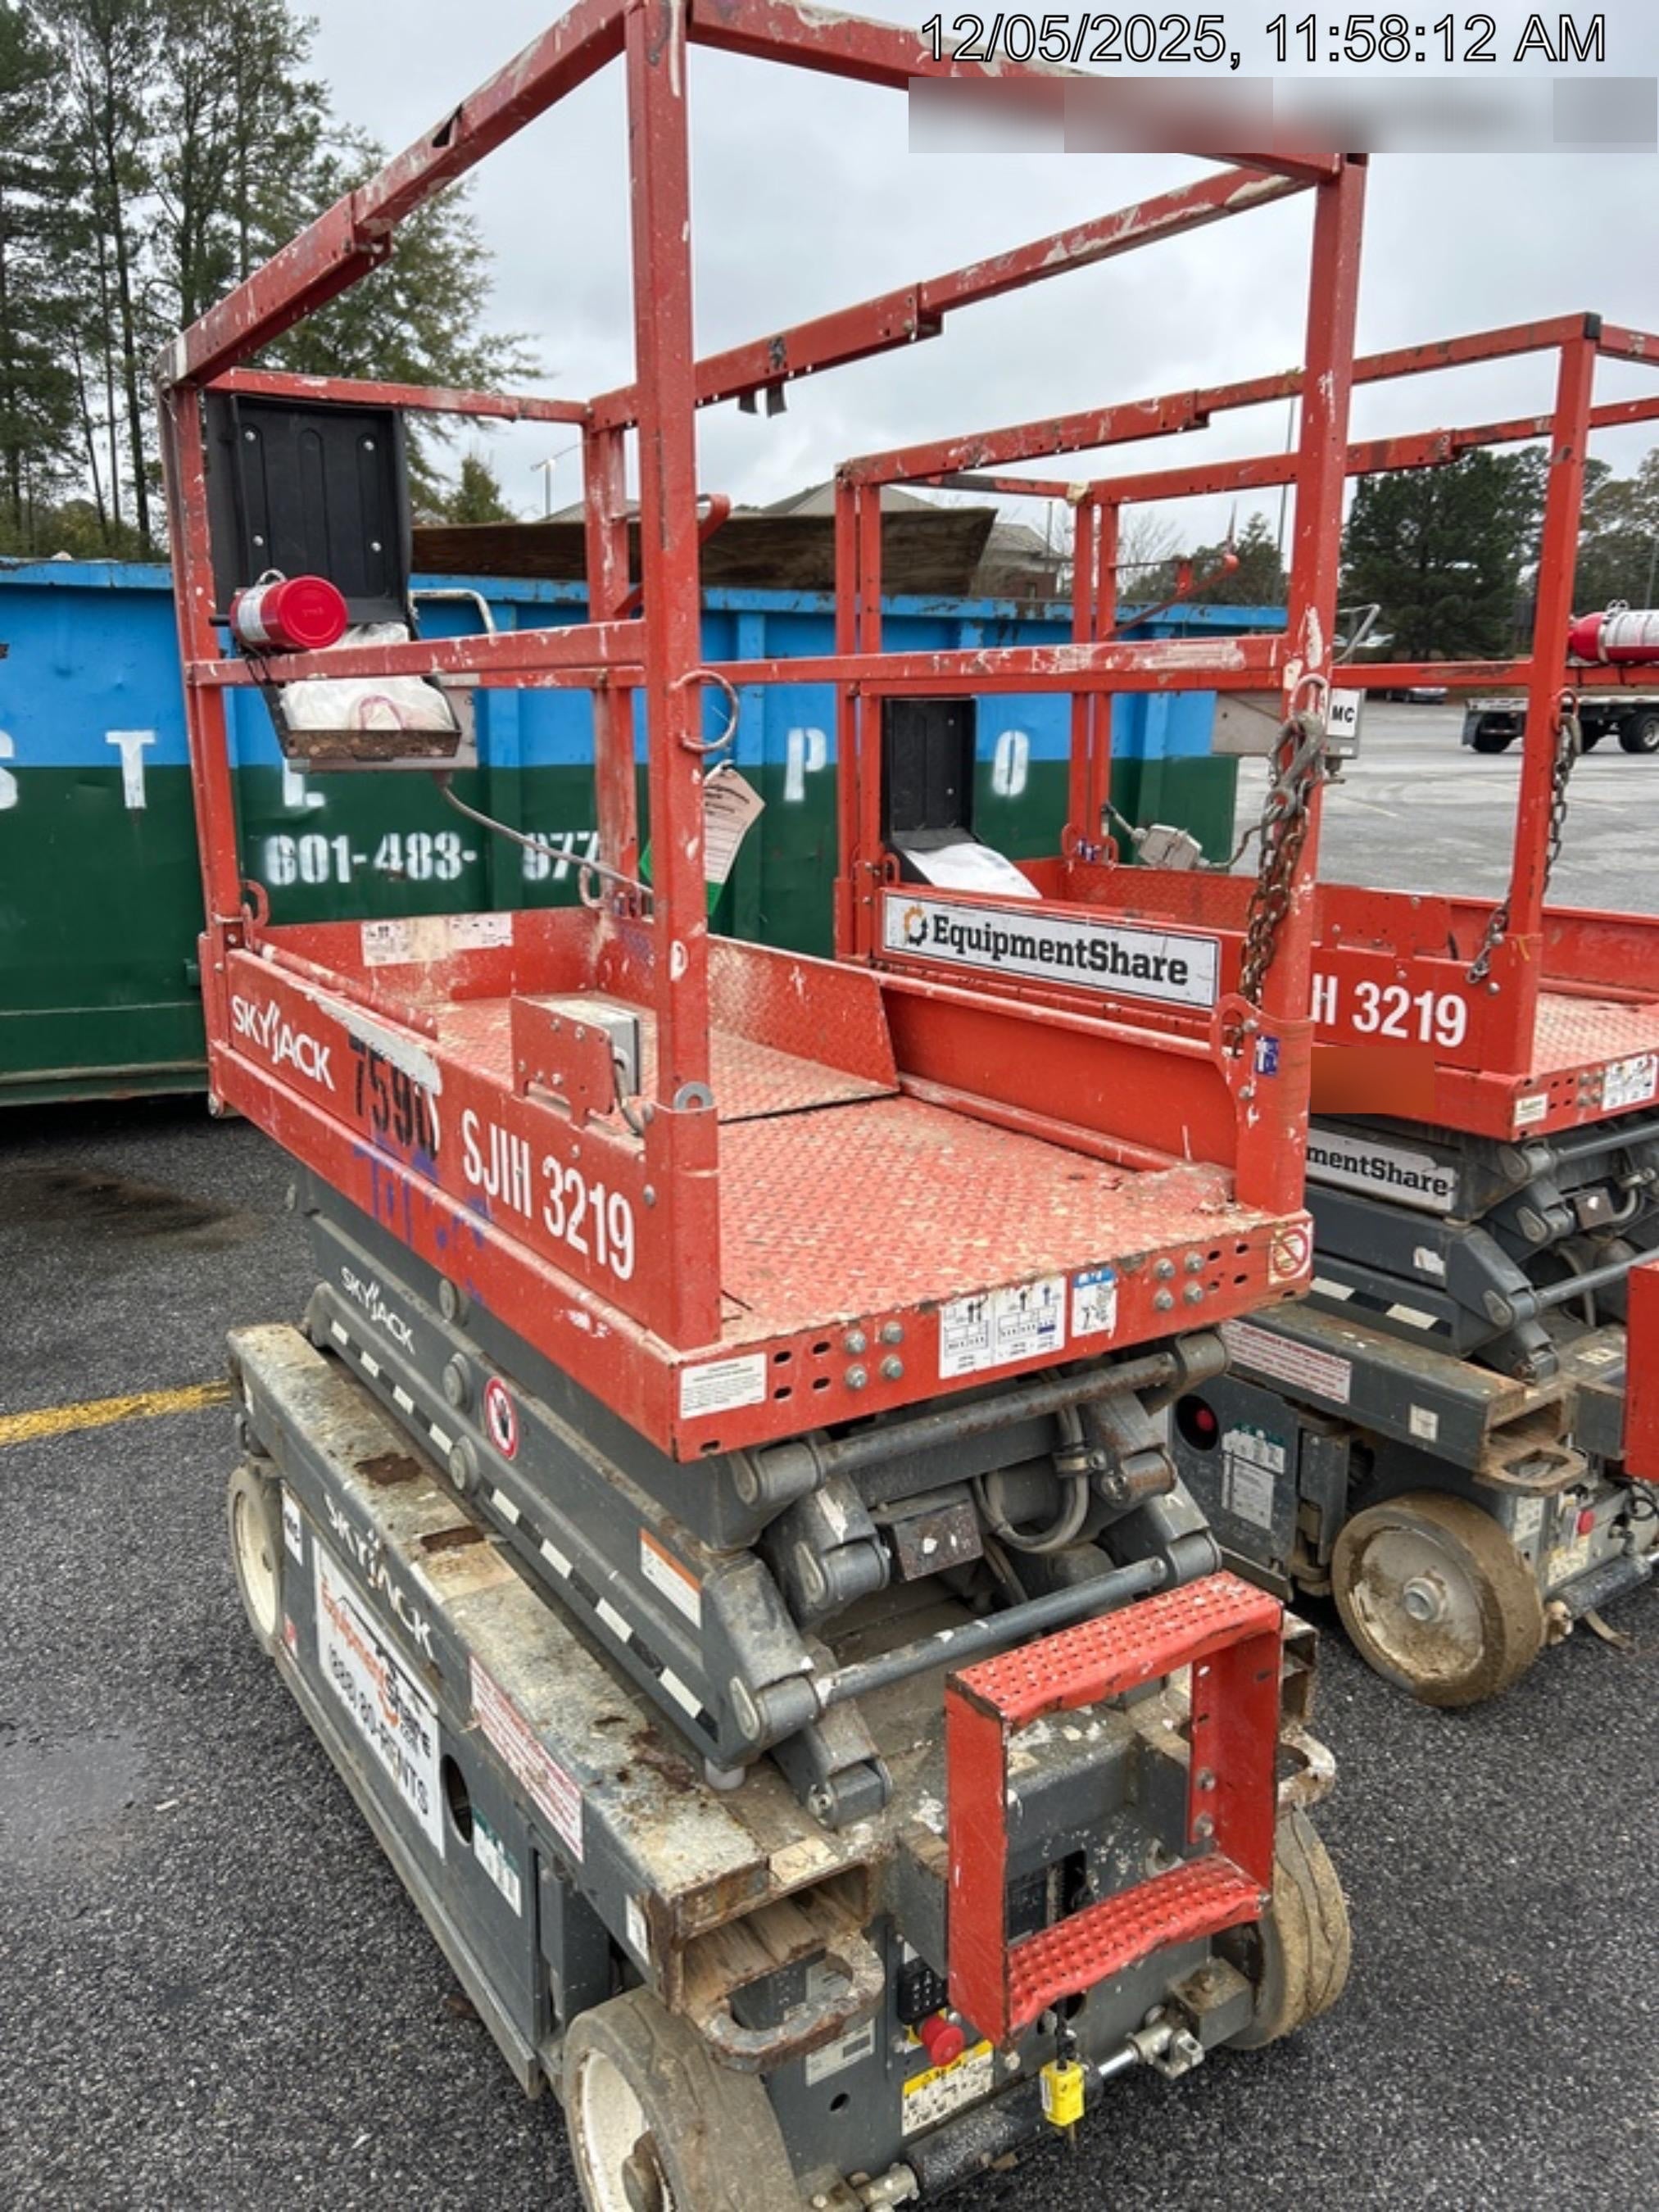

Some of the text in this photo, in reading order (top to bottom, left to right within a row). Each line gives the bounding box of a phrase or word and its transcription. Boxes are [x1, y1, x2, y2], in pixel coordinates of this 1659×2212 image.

[1331, 705, 1356, 723] MC
[932, 913, 1189, 985] EquipmentShare
[232, 995, 336, 1092] SKYJACK
[1352, 980, 1466, 1049] 3219
[1306, 1145, 1448, 1197] mentShare
[542, 1154, 635, 1281] 3219
[341, 1266, 415, 1356] SKYJACK
